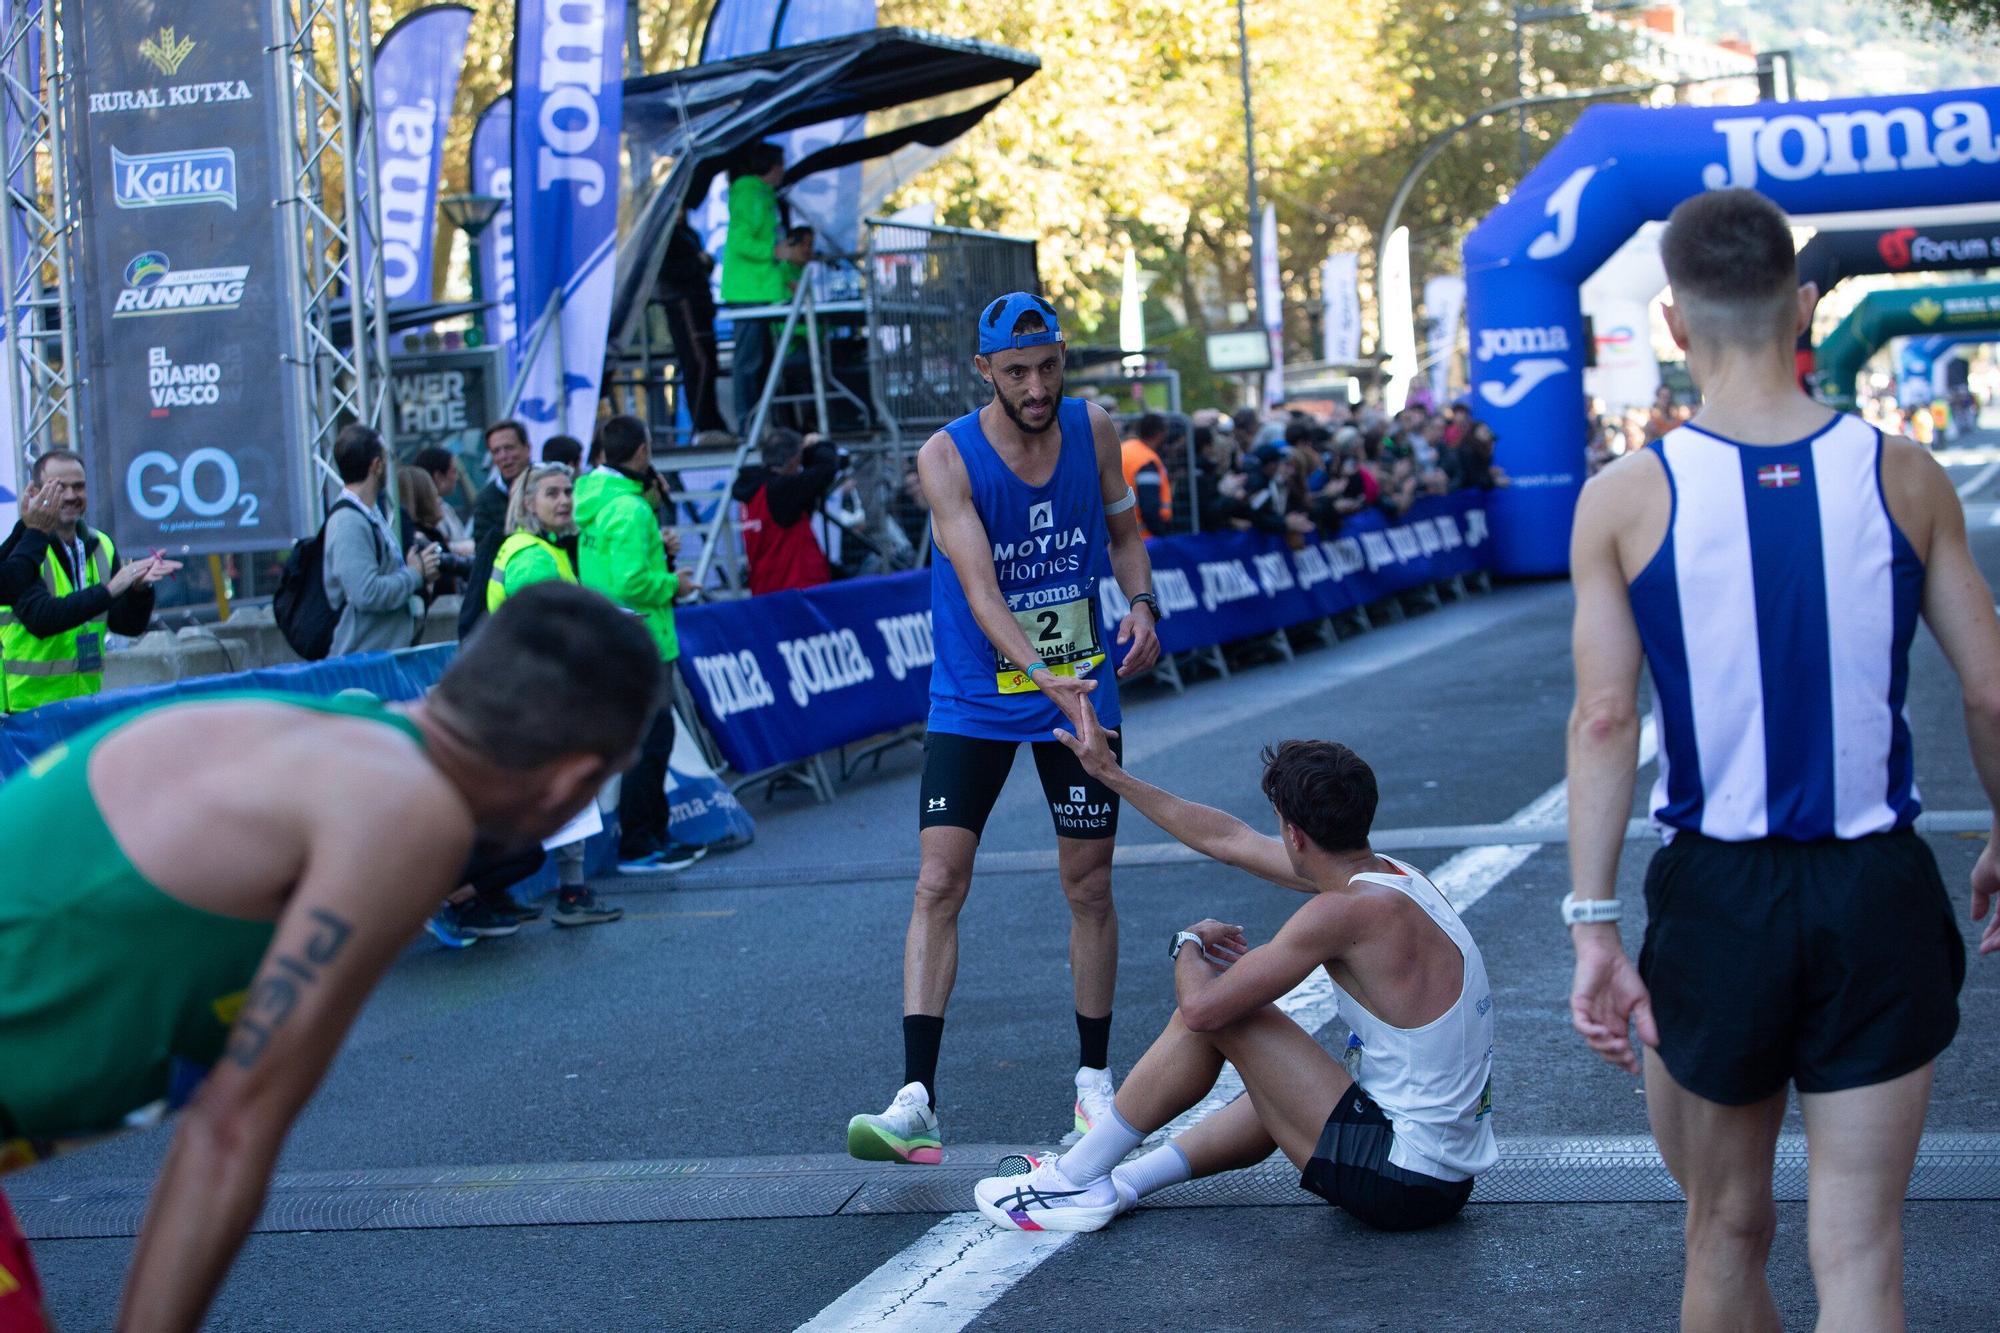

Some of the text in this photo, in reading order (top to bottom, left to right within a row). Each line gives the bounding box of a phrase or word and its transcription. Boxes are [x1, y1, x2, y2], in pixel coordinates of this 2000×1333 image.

[90, 80, 252, 113] RURAL KUTXA
[124, 161, 224, 199] Kaiku
[378, 97, 437, 298] oma
[115, 281, 245, 311] RUNNING
[149, 346, 172, 366] EL
[150, 363, 221, 387] DIARIO
[151, 385, 220, 408] VASCO
[993, 526, 1087, 562] MOYUA
[1000, 554, 1080, 581] Homes
[1036, 610, 1063, 642] 2
[875, 609, 936, 681] Jom
[1053, 802, 1112, 816] MOYUA
[1059, 815, 1107, 829] Homes
